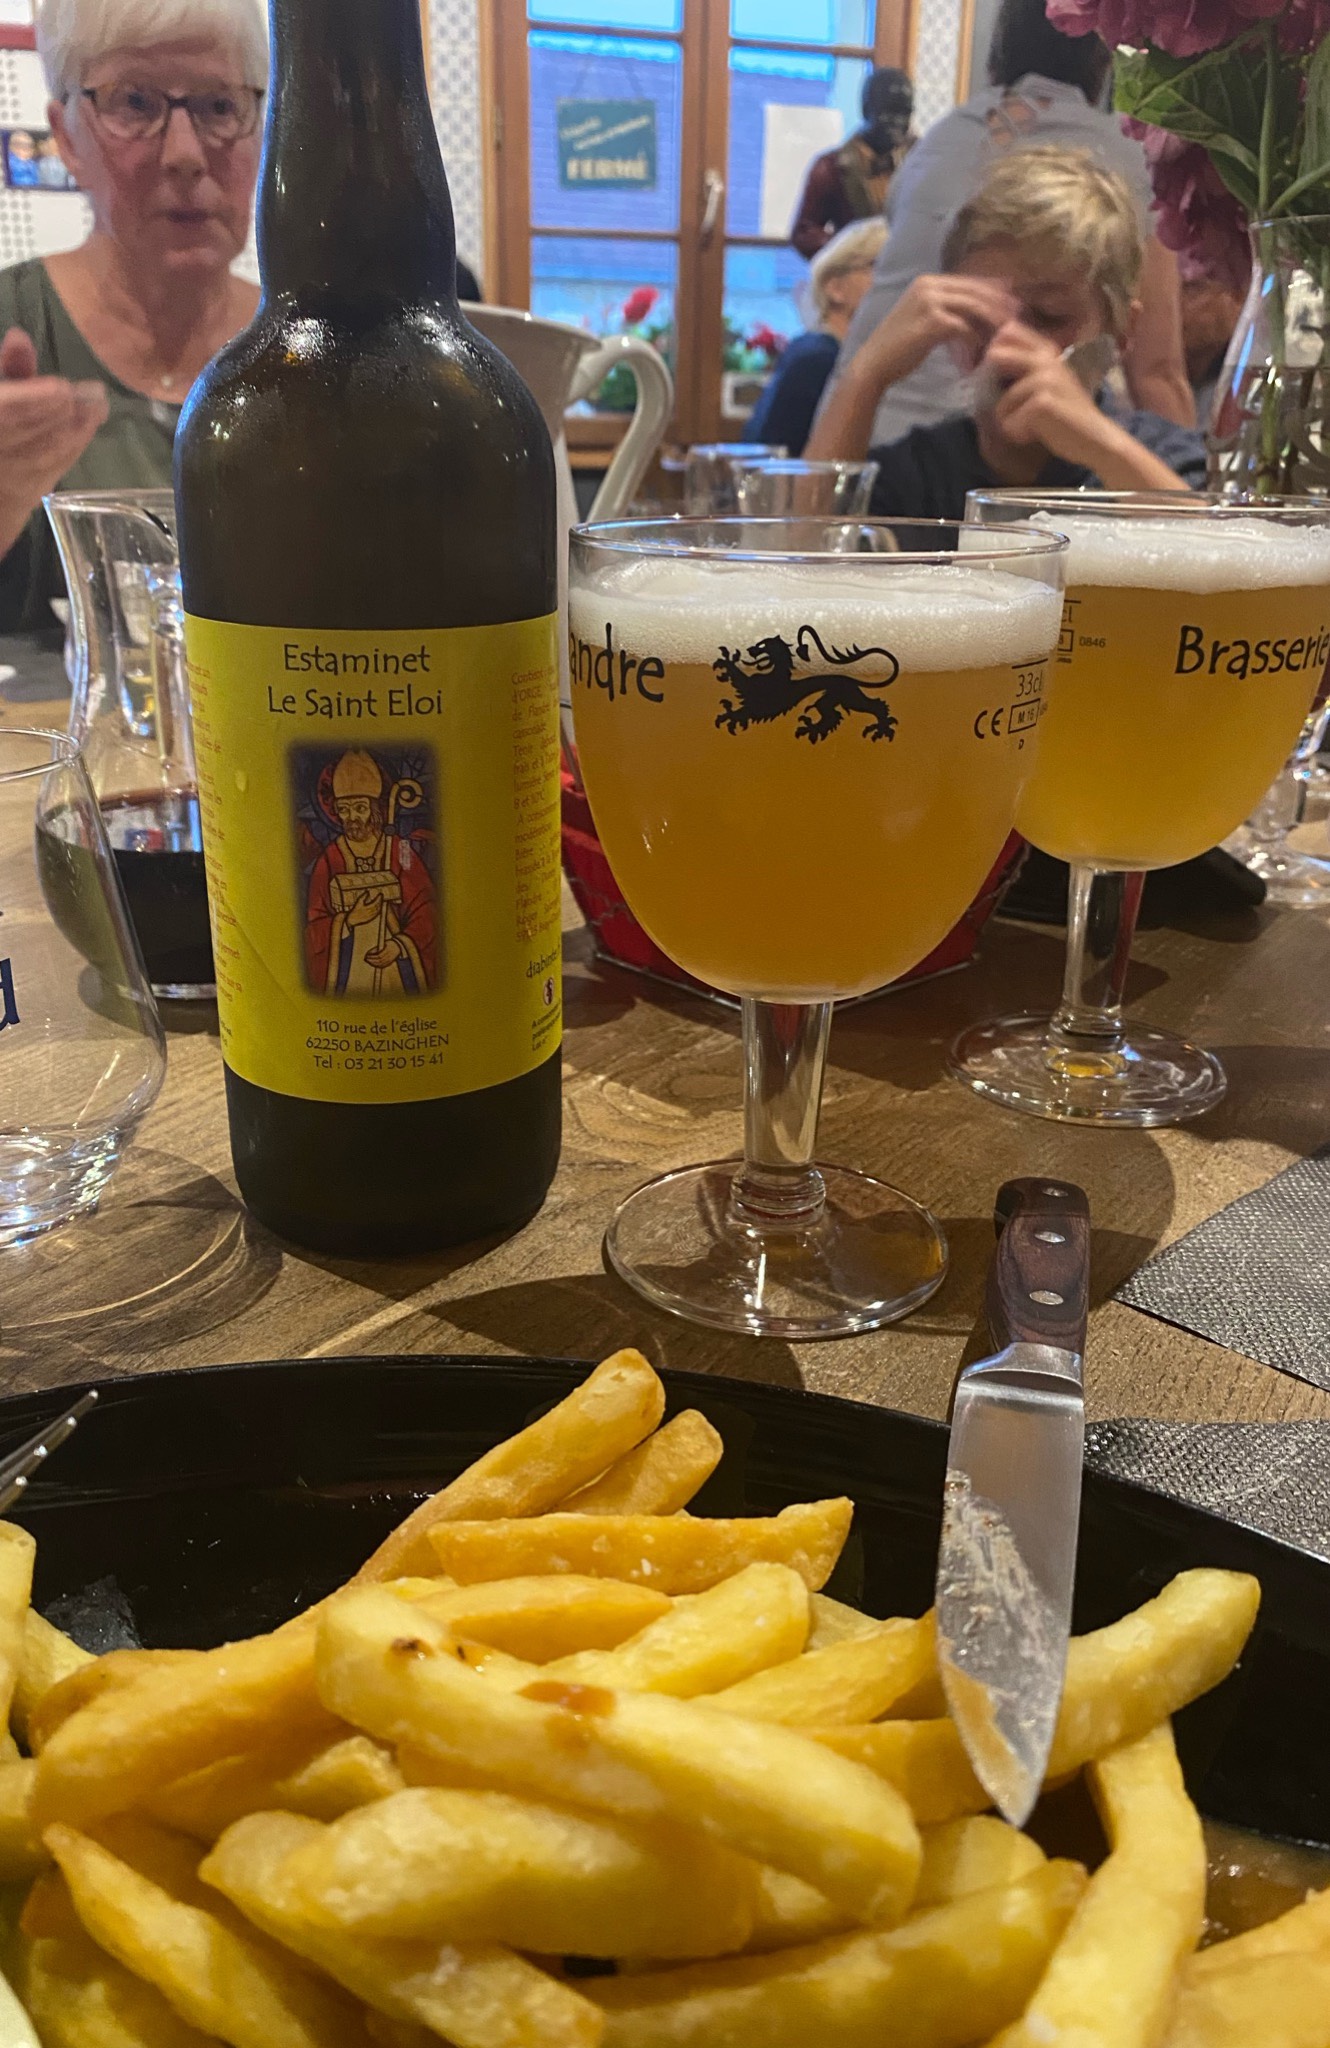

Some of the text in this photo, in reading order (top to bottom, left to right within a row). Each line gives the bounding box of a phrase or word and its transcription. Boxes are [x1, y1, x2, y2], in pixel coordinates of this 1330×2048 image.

[1079, 636, 1106, 648] 0846
[1175, 625, 1330, 680] Brasserie
[284, 643, 431, 676] Estaminet
[1016, 669, 1044, 698] 33cl
[268, 683, 442, 720] Le Saint Eloi
[316, 1017, 437, 1036] 110 rue de l'église
[306, 1034, 449, 1052] 62250 BAZINGHEN
[313, 1055, 333, 1069] Tel
[344, 1057, 364, 1070] 03
[368, 1057, 383, 1070] 21
[387, 1056, 407, 1070] 30
[410, 1055, 425, 1068] 15
[428, 1052, 444, 1065] 41
